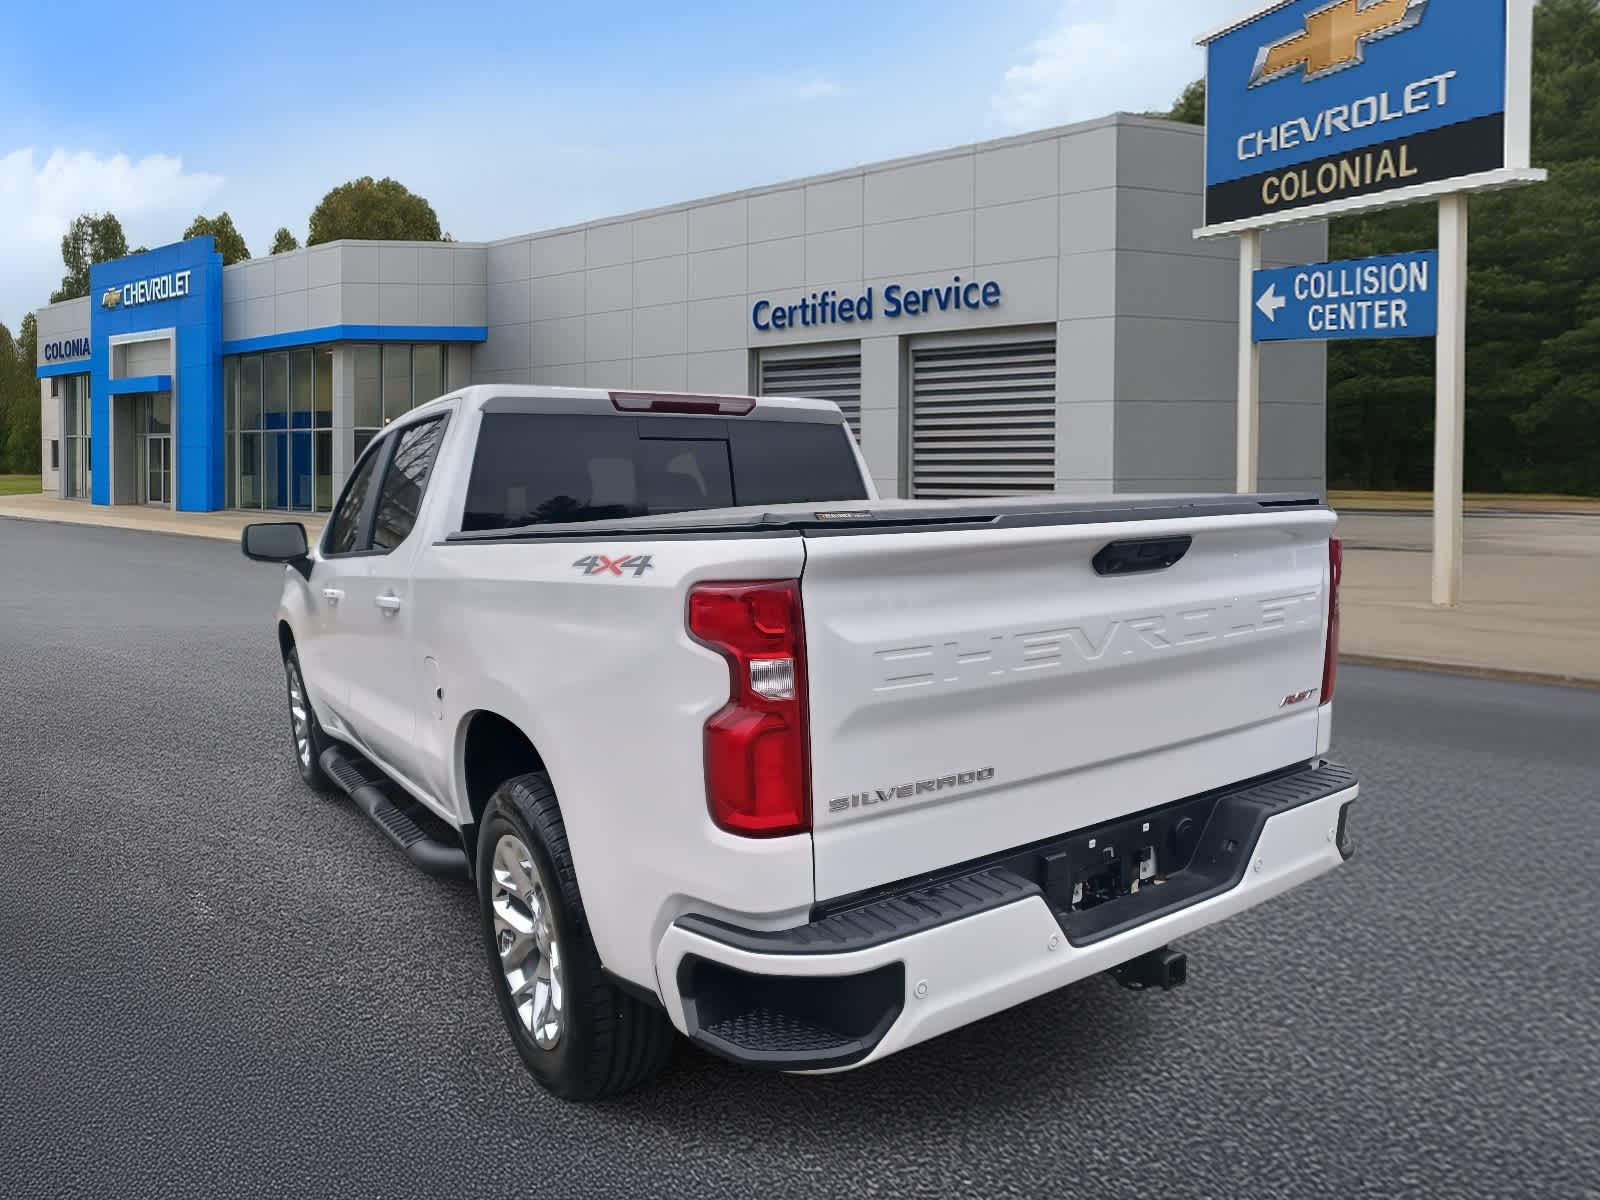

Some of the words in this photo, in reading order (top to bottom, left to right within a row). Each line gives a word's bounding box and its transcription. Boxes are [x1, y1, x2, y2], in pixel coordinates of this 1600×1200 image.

[1236, 70, 1457, 161] CHEVROLET
[1261, 144, 1418, 205] COLONIAL
[123, 270, 192, 306] CHEVROLET
[752, 287, 873, 331] Certified
[883, 275, 1002, 318] Service
[1293, 259, 1428, 301] COLLISION
[1307, 299, 1409, 332] CENTER
[872, 591, 1318, 692] CHEVROLET
[828, 767, 996, 813] SILVERADO
